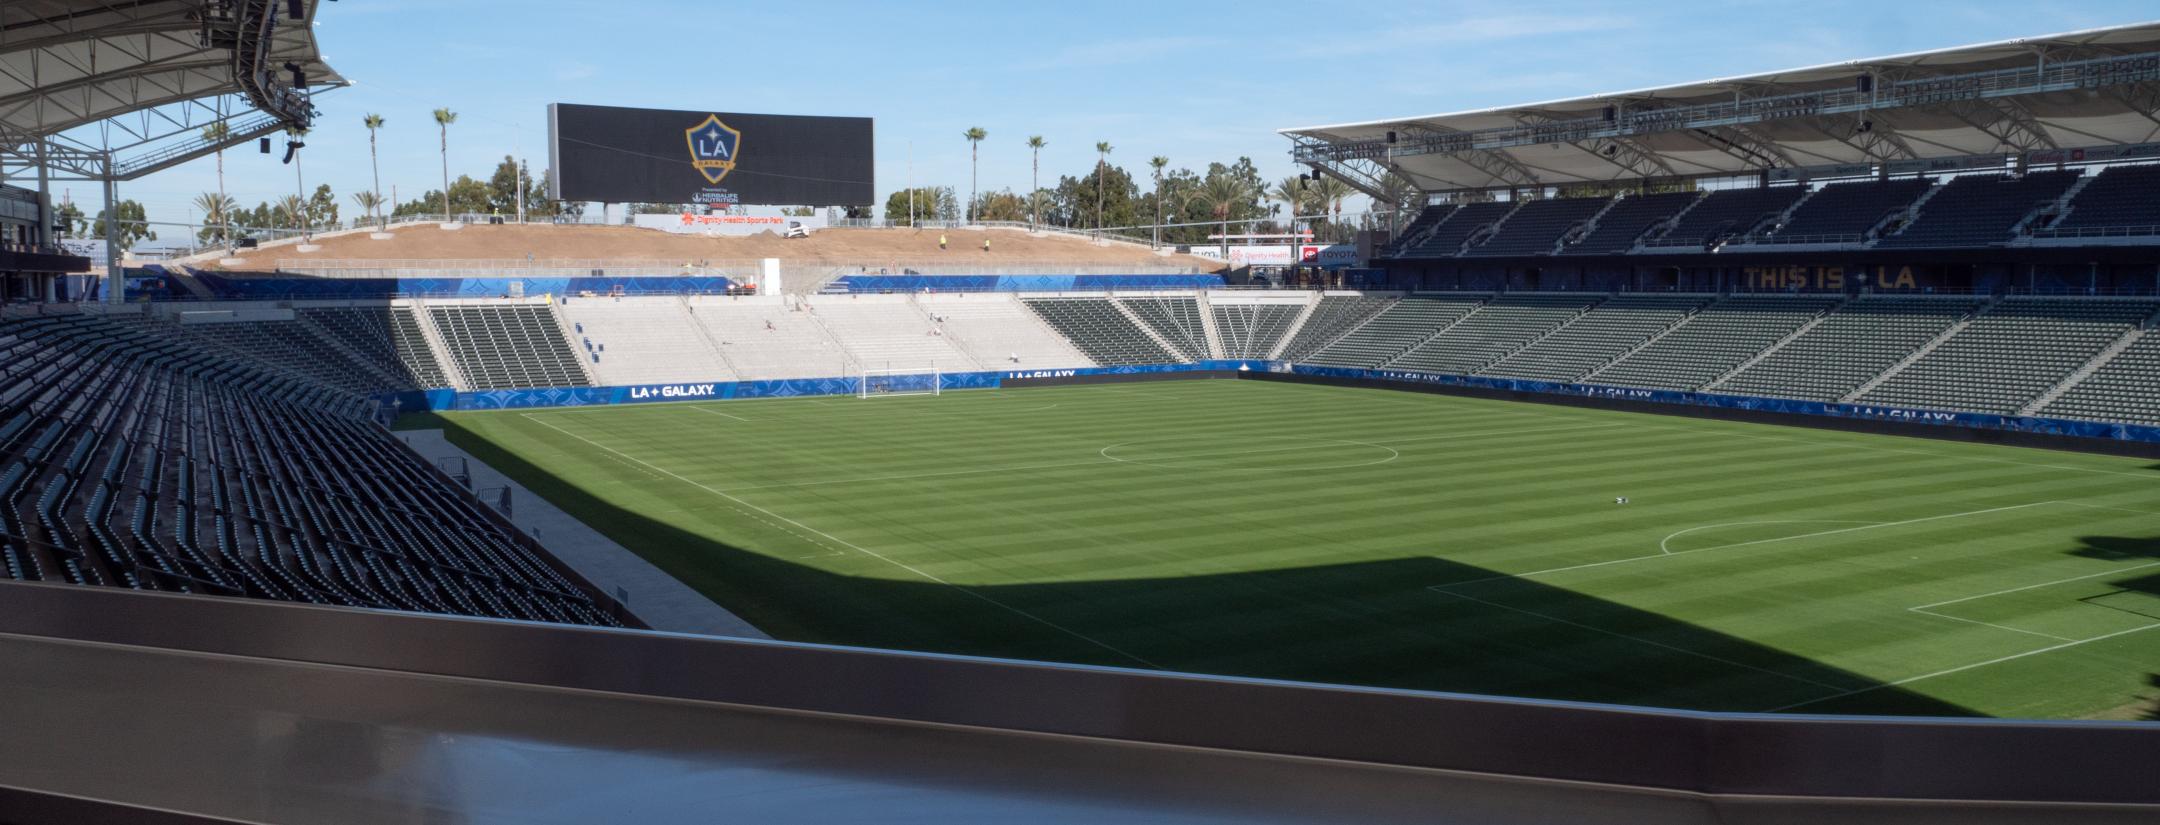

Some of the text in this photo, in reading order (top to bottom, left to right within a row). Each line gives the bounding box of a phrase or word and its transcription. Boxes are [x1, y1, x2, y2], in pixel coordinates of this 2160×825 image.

[699, 139, 729, 157] LA
[698, 216, 721, 225] Dignity
[723, 216, 746, 224] Health
[747, 216, 768, 225] Sports
[1321, 251, 1358, 259] TOYOTA
[1744, 265, 1917, 289] THIS IS LA
[631, 387, 650, 398] LA
